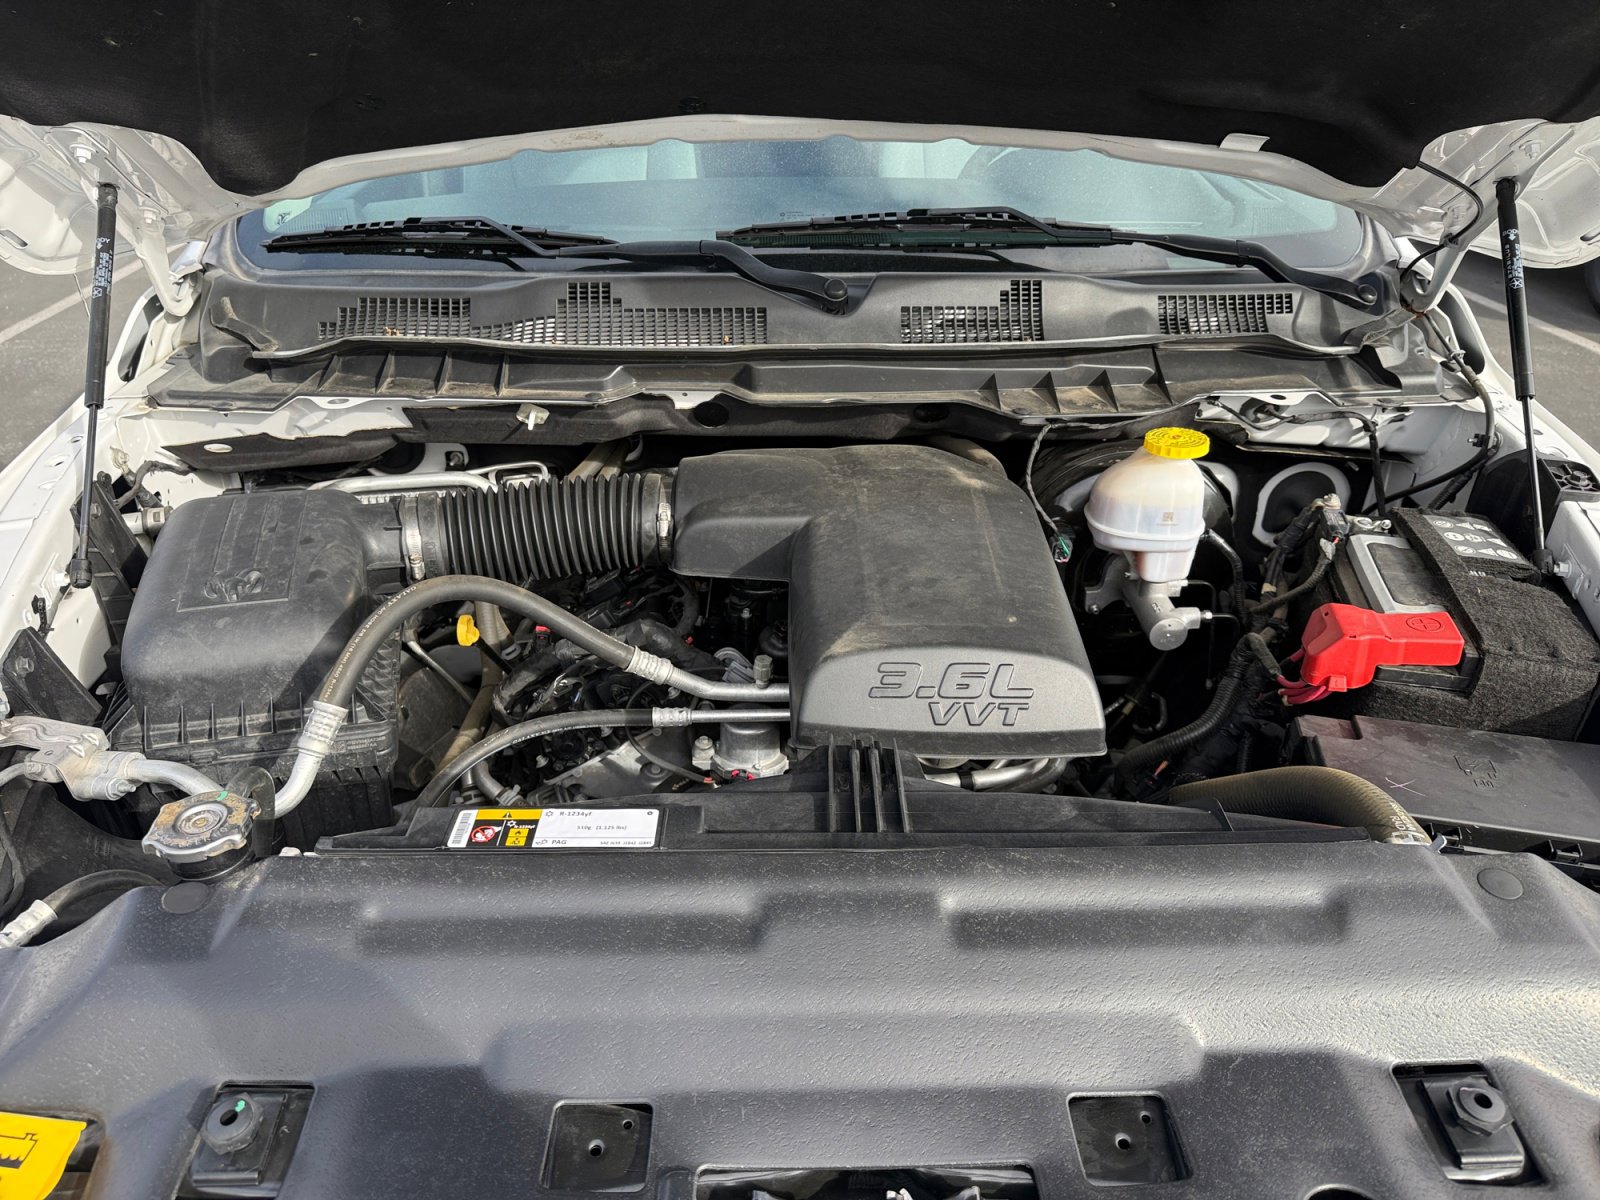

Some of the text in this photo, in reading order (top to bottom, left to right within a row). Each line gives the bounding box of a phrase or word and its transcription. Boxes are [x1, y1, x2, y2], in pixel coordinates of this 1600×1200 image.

[388, 586, 417, 606] GALAXY
[365, 615, 379, 628] HOSE
[868, 662, 1034, 699] 3.6L
[928, 702, 1030, 726] VVT
